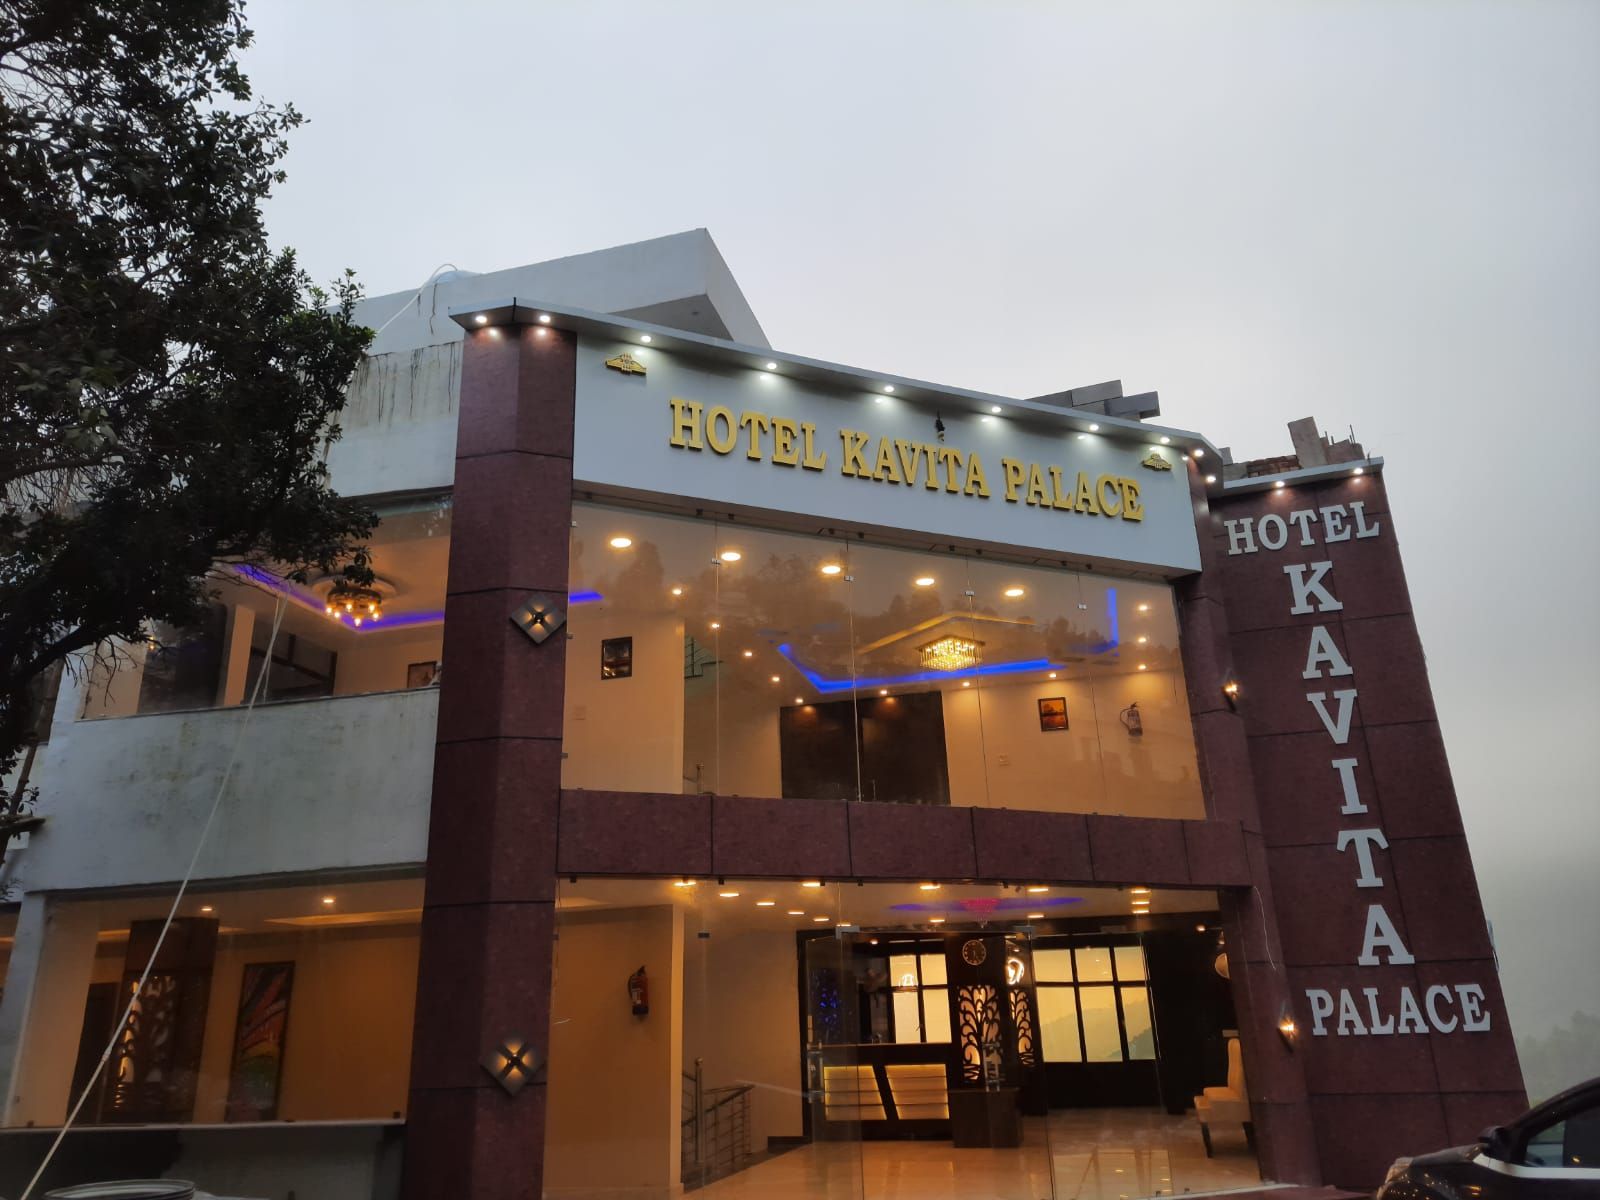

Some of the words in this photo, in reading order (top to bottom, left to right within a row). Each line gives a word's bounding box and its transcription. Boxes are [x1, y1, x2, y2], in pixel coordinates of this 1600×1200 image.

[670, 399, 827, 471] HOTEL
[840, 429, 990, 497] KAVITA
[1003, 458, 1144, 521] PALACE
[1223, 501, 1380, 555] HOTEL
[1283, 560, 1415, 966] KAVITA
[1305, 983, 1491, 1036] PALACE
